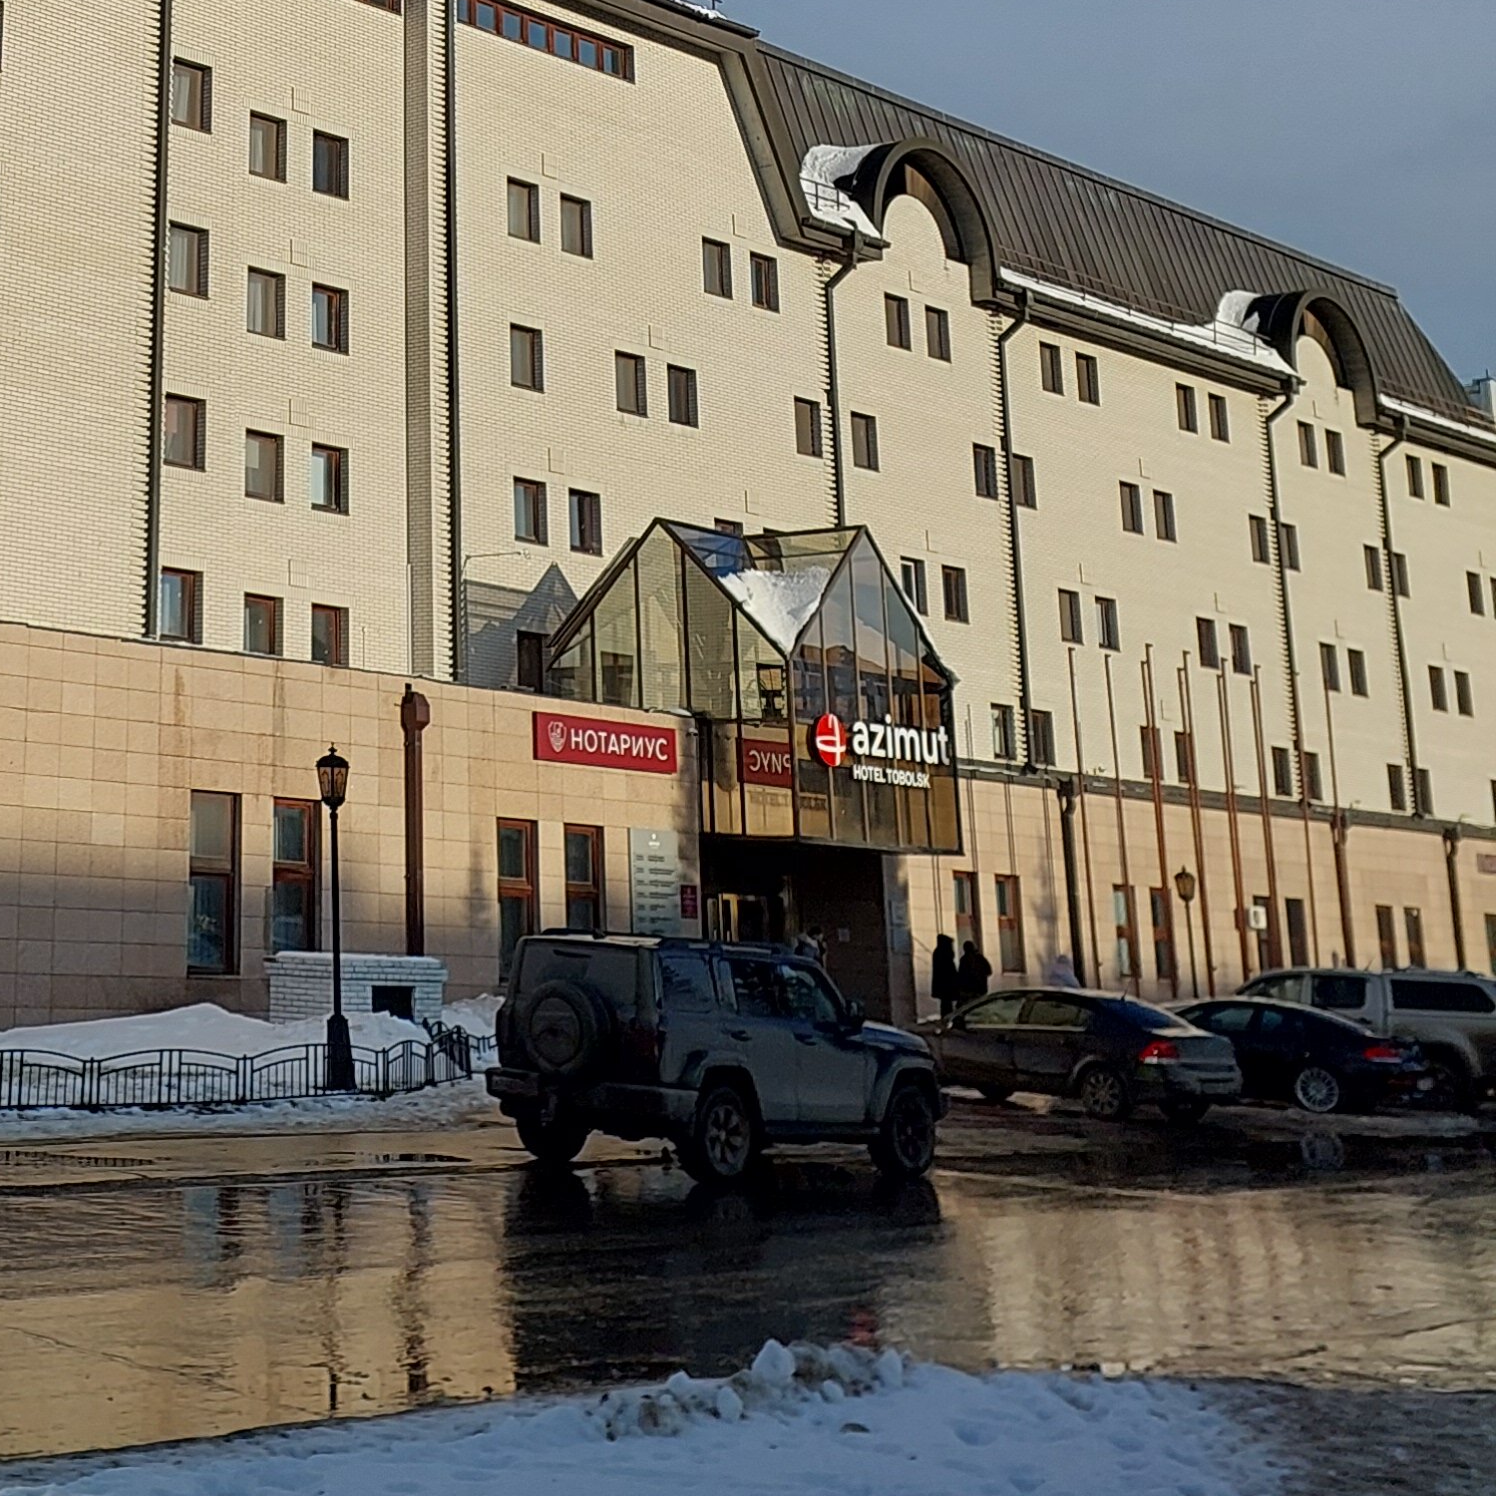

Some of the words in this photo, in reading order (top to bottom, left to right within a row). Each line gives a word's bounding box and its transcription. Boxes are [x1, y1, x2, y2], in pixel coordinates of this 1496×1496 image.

[570, 727, 668, 761] НОТАРИУС
[852, 713, 950, 766] azimut
[852, 764, 886, 784] HOTEL
[886, 767, 931, 789] TOBOLSK
